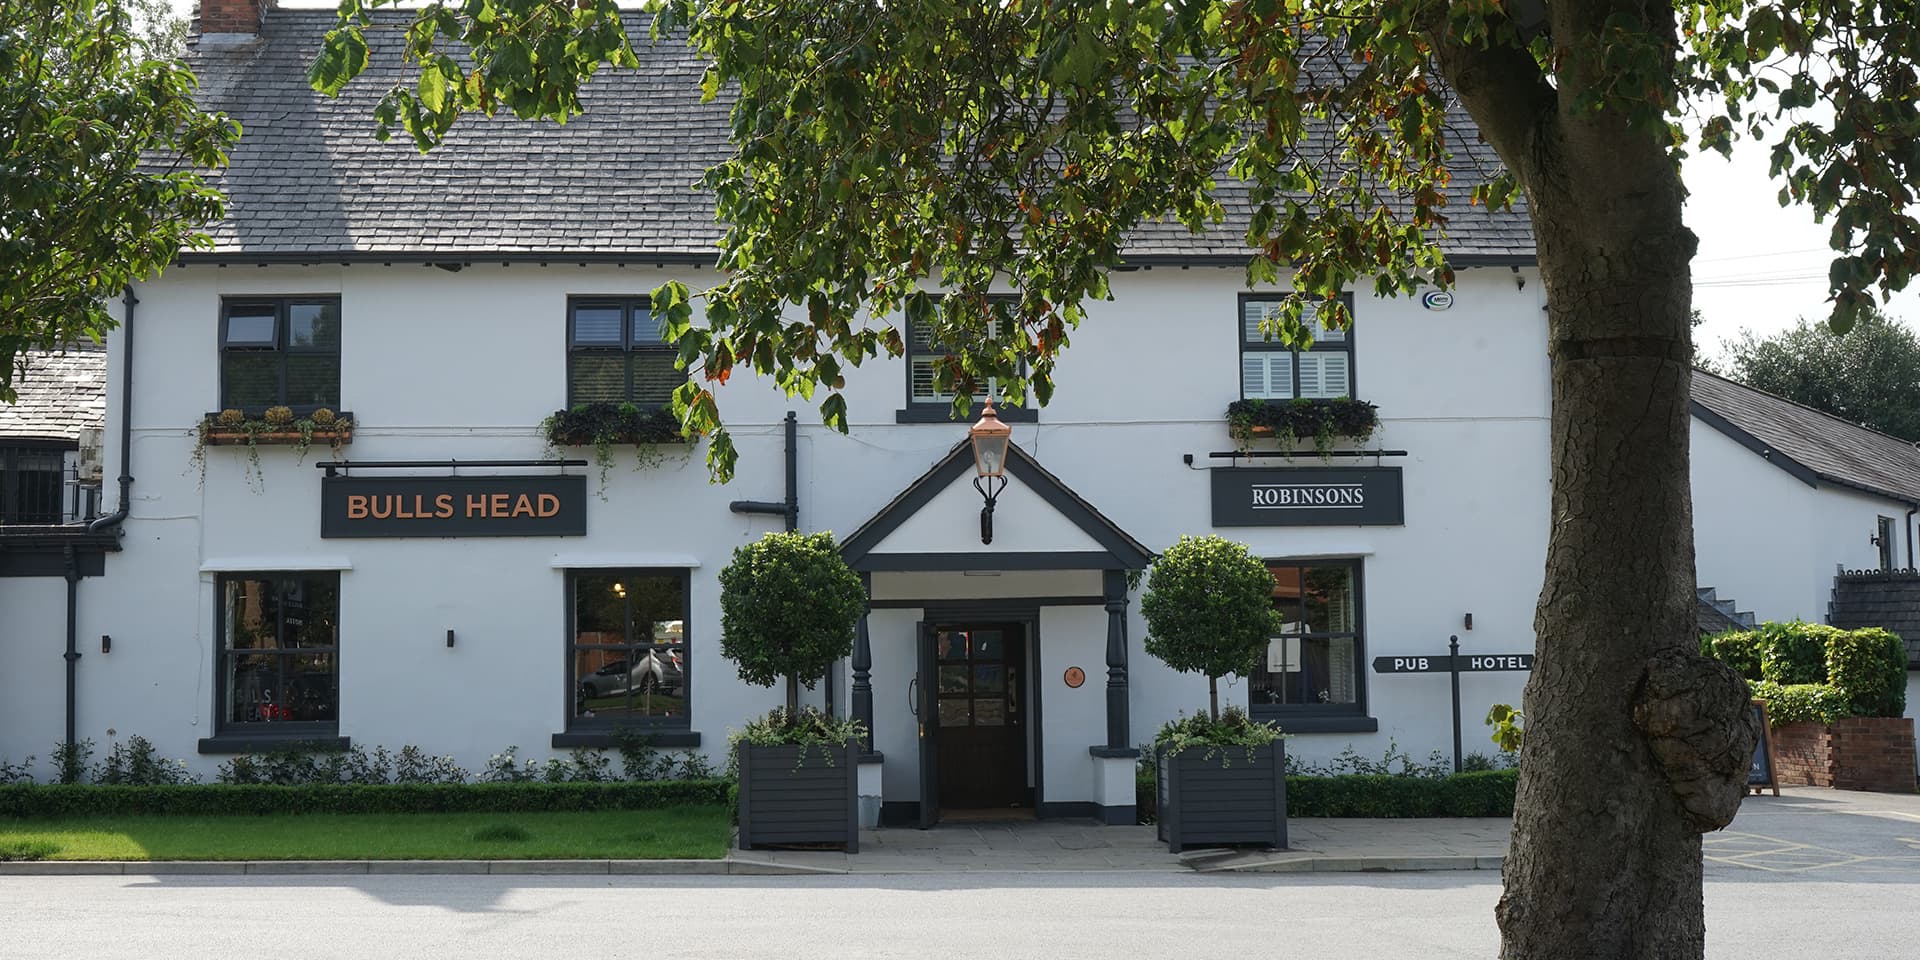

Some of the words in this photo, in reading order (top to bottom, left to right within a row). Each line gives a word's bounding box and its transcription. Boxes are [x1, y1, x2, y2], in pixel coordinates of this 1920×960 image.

[1252, 488, 1364, 505] ROBINSONS
[347, 494, 454, 519] BULLS
[466, 493, 561, 518] HEAD
[1394, 658, 1430, 671] PUB
[1471, 657, 1528, 670] HOTEL
